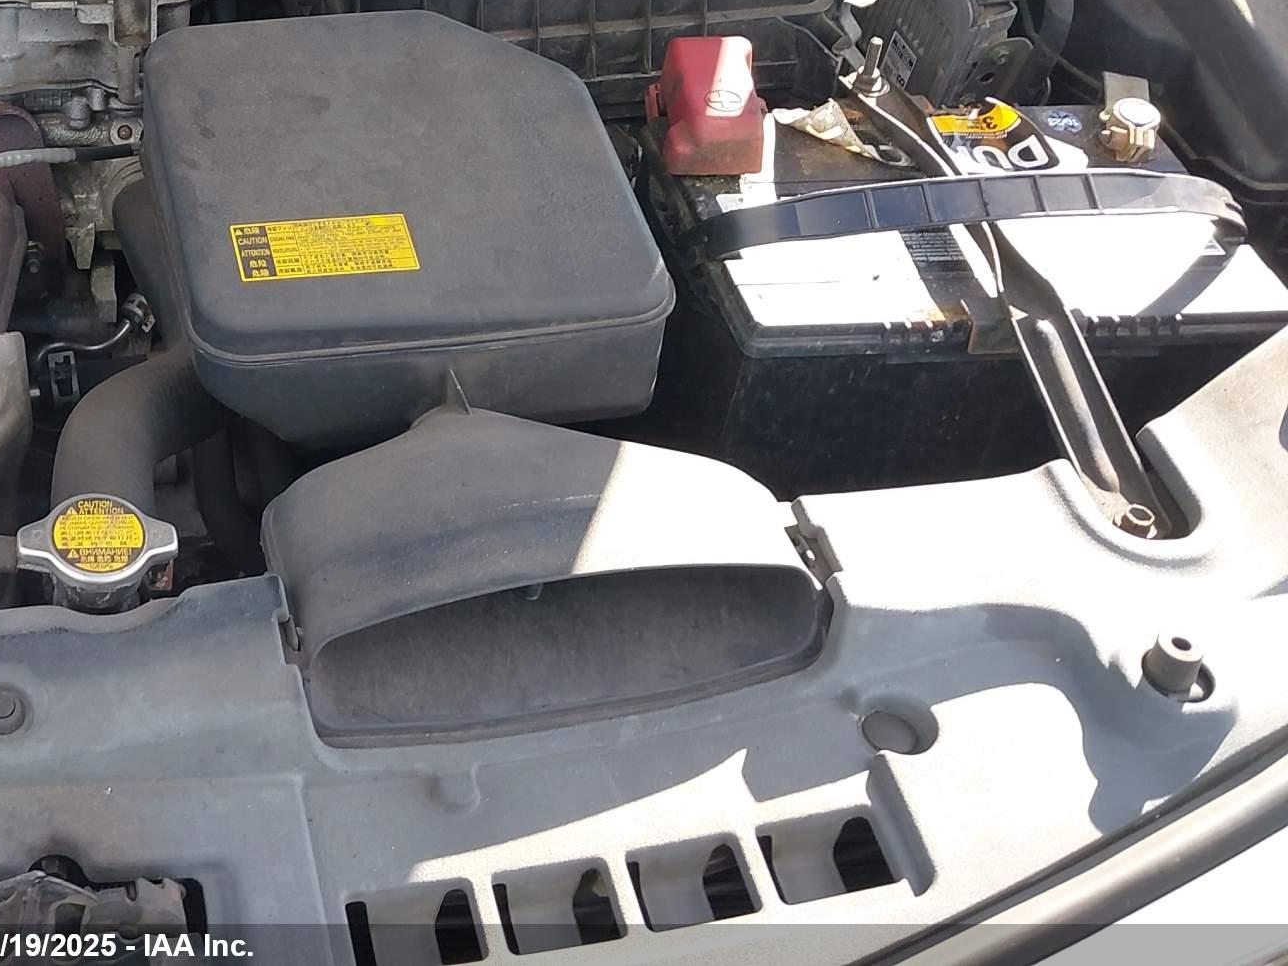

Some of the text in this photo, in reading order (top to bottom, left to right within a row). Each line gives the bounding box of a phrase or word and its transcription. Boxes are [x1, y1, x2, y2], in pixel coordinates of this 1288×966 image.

[982, 116, 998, 130] 3
[237, 236, 268, 246] CAUTION
[241, 248, 271, 258] ATTENTION
[77, 500, 113, 508] CAUTION
[78, 507, 124, 515] ATTENTION
